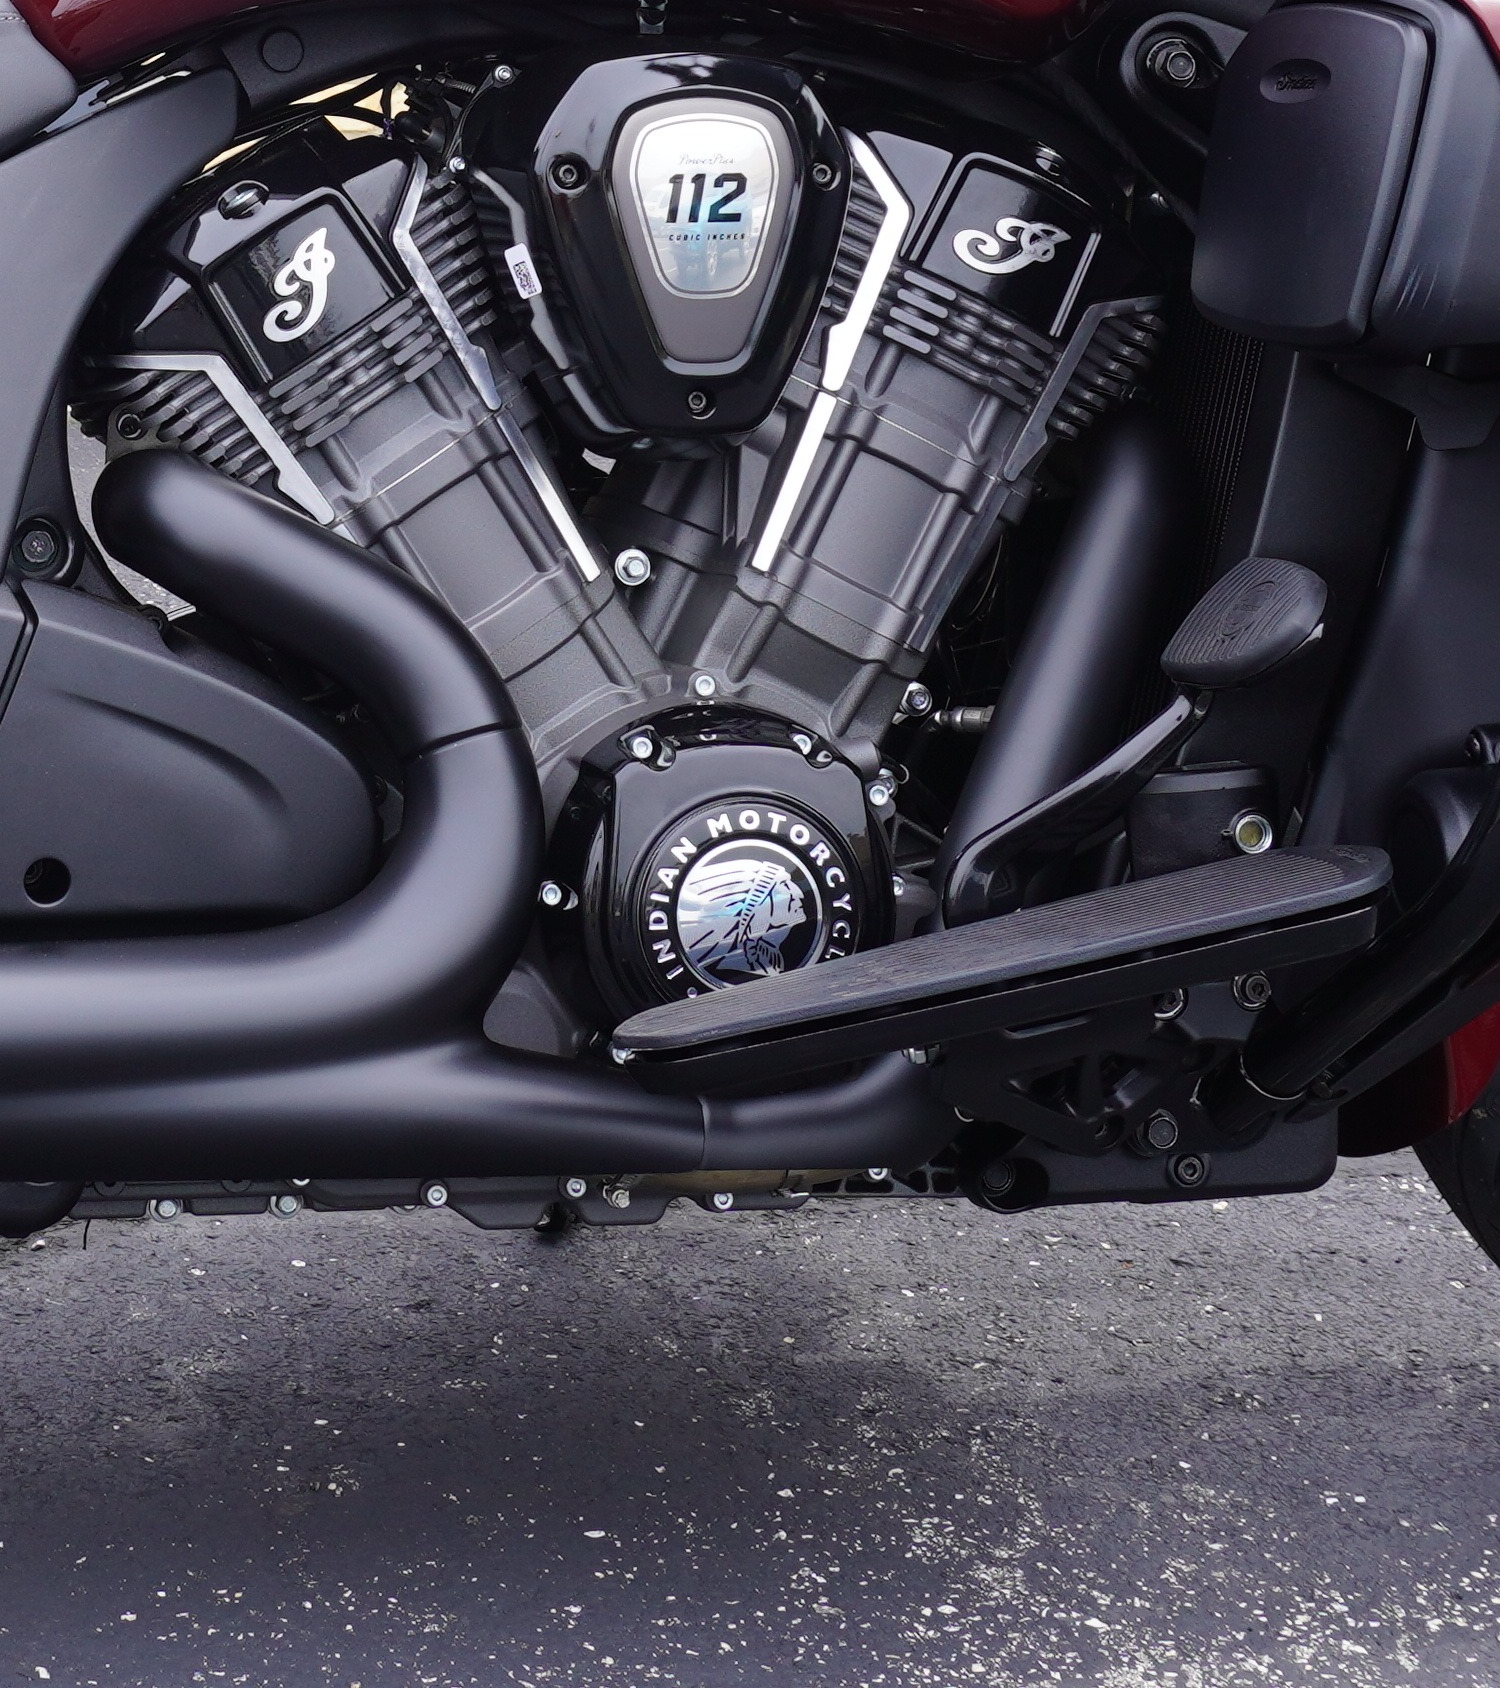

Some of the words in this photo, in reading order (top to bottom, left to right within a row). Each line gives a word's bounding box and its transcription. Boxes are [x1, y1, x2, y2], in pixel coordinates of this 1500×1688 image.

[665, 172, 748, 224] 112
[668, 234, 701, 242] CUBIC
[707, 232, 746, 241] INCHES
[648, 836, 698, 981] INDIAN
[706, 809, 853, 961] MOTORCYCL
